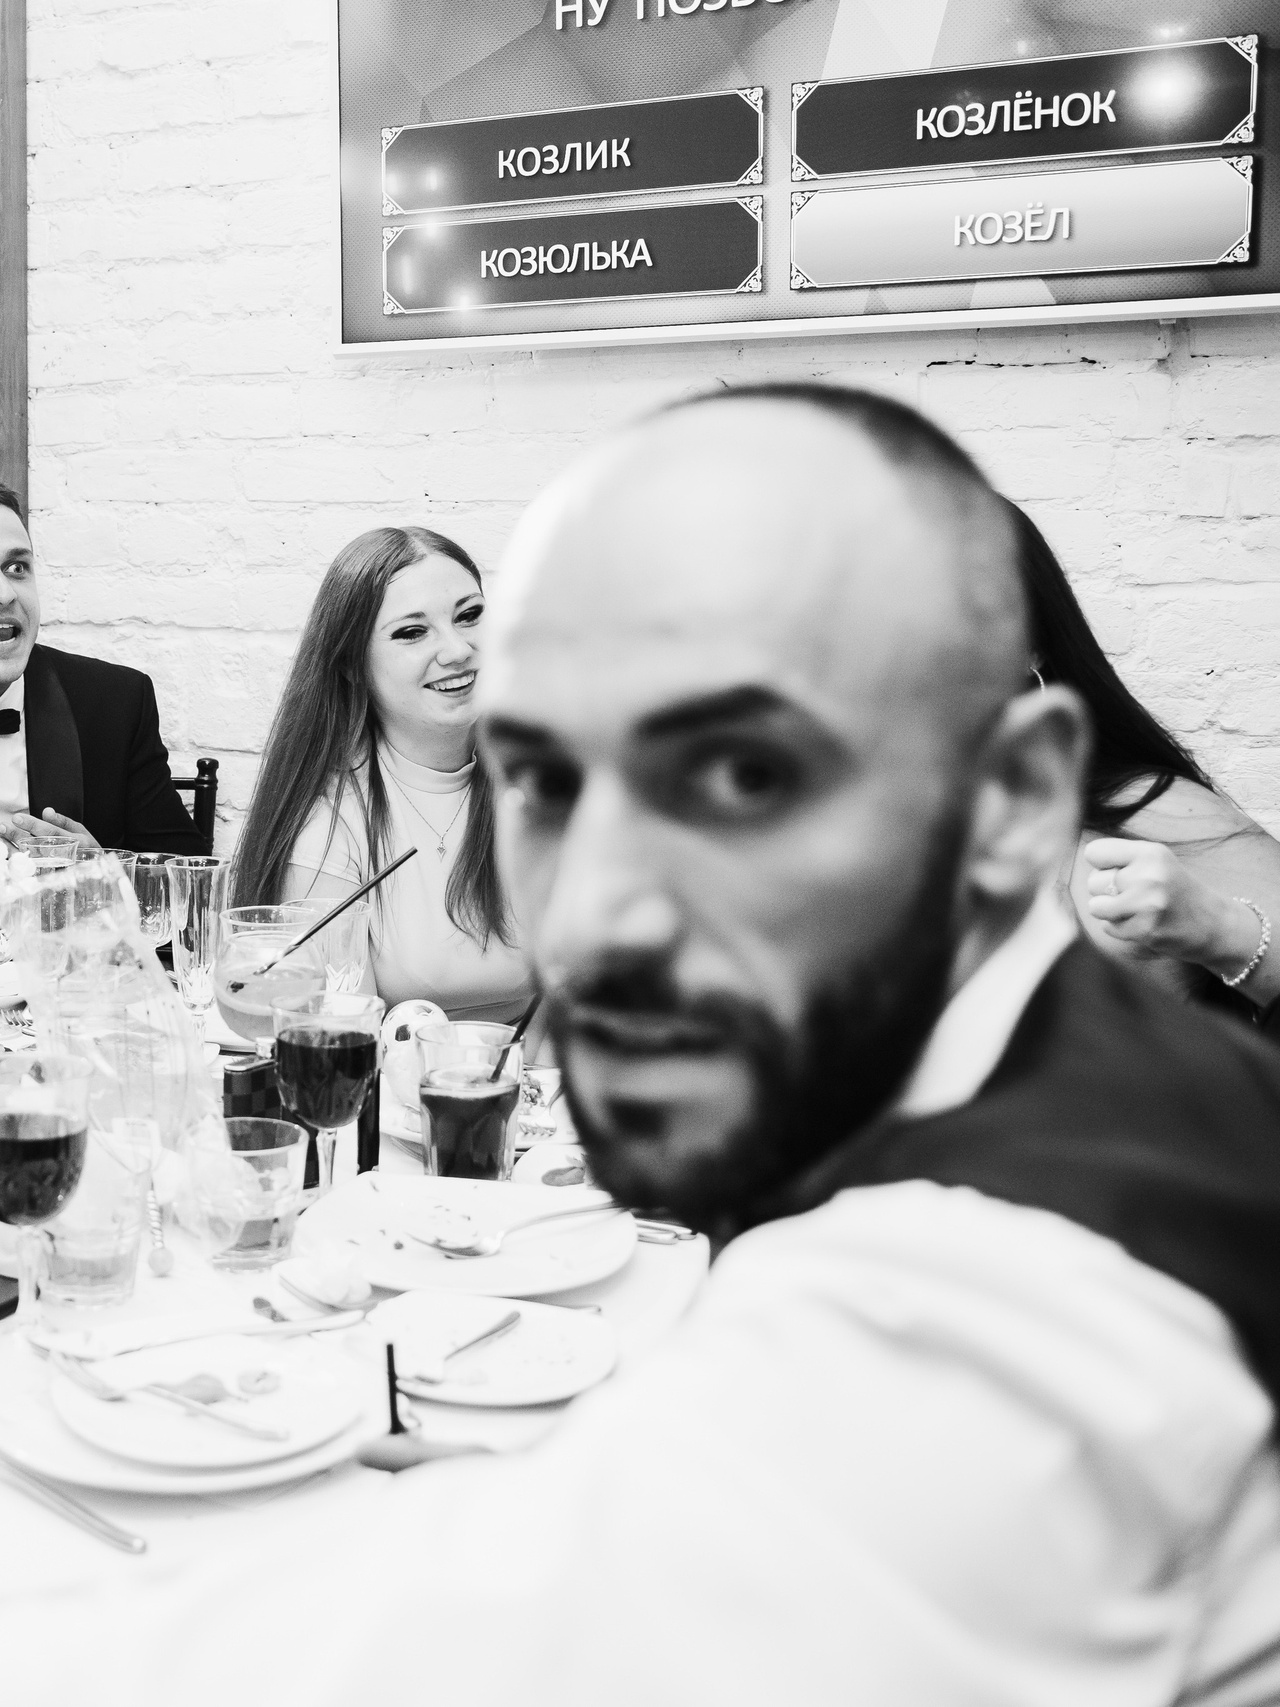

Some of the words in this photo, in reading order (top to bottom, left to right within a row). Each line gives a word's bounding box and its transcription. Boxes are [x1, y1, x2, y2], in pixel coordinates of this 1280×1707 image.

[916, 90, 1117, 140] КОЗЛЁНОК
[498, 138, 631, 179] КОЗЛИК
[953, 202, 1071, 246] КОЗЁЛ
[480, 238, 653, 278] КОЗЮЛЬКА
